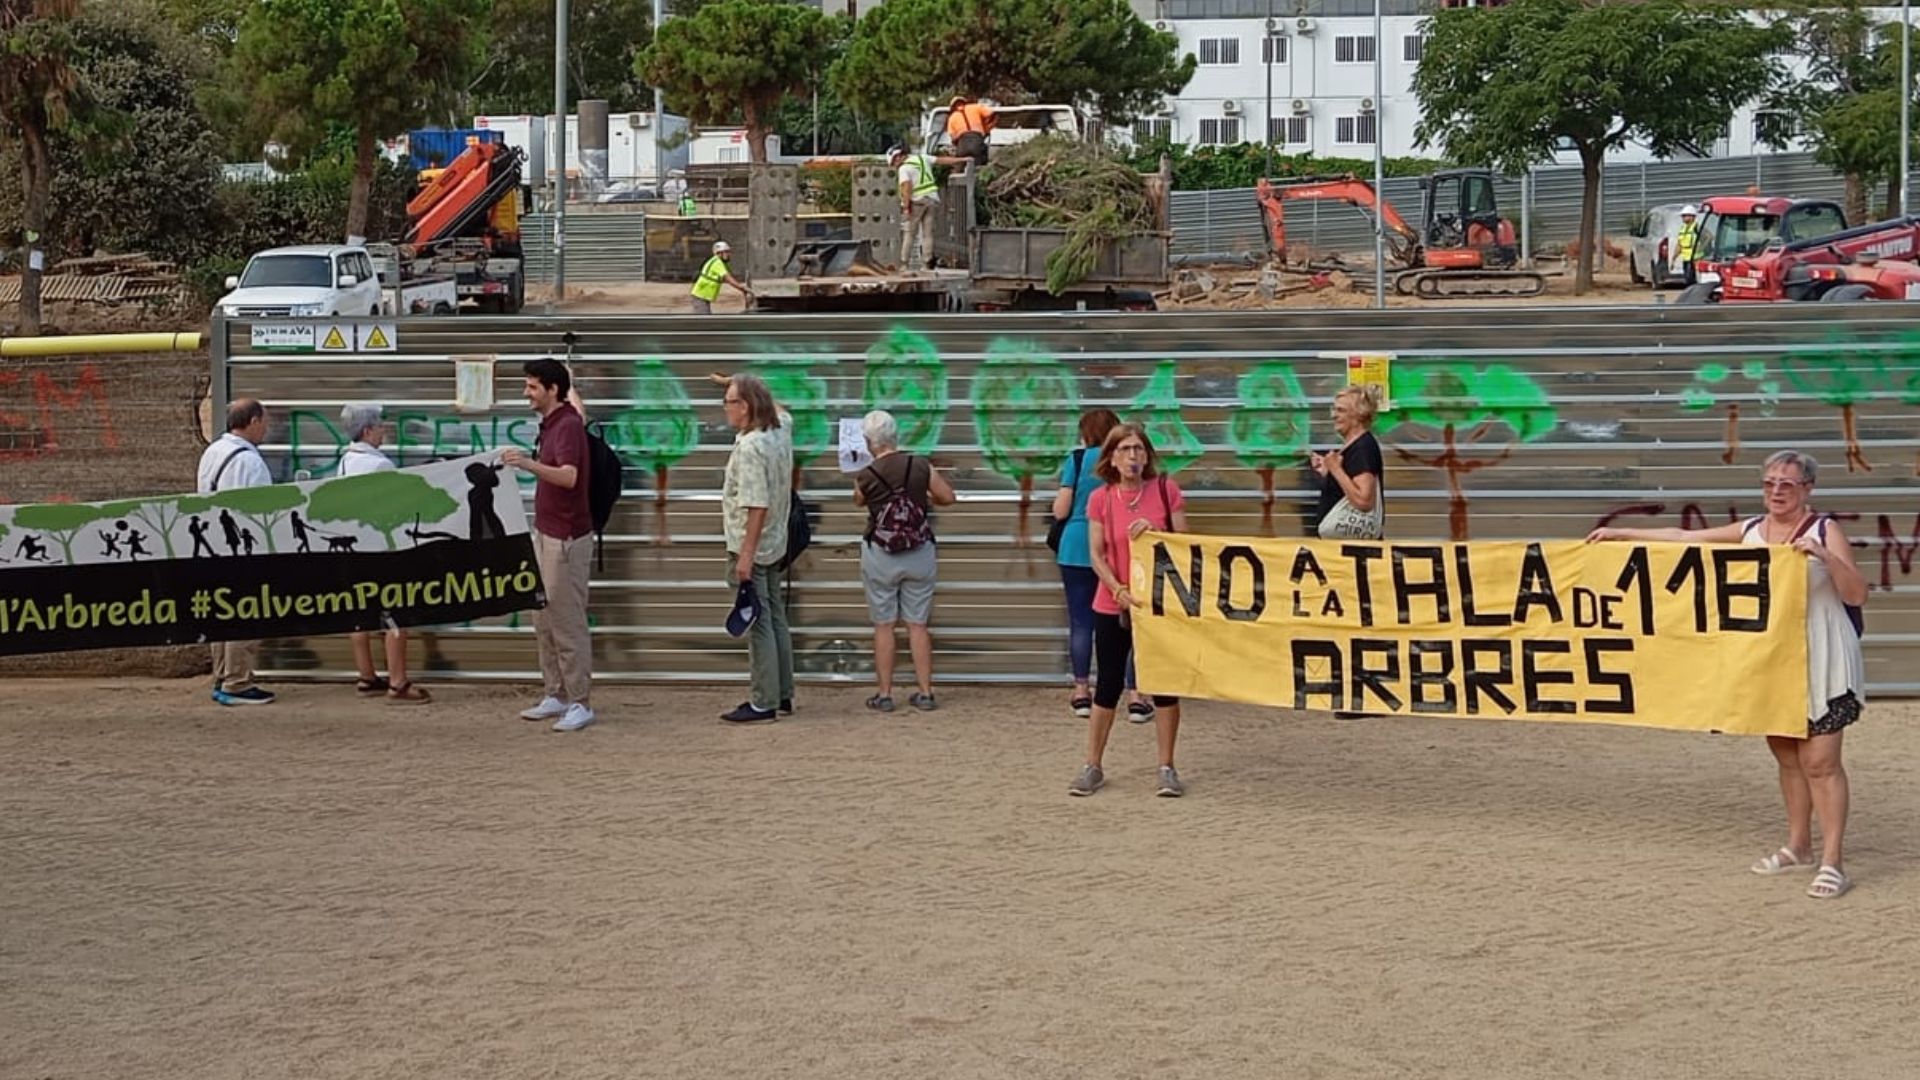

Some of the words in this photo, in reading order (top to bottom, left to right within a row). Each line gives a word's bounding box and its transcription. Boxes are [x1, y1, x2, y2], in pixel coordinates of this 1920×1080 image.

[190, 559, 537, 621] #SalvemParcMiró
[1151, 540, 1267, 622] NO
[1289, 546, 1328, 586] A
[1341, 542, 1564, 628] TALA
[1615, 546, 1772, 636] 118
[1292, 589, 1344, 618] LA
[1572, 586, 1625, 630] DE
[1290, 638, 1636, 716] ARBRES
